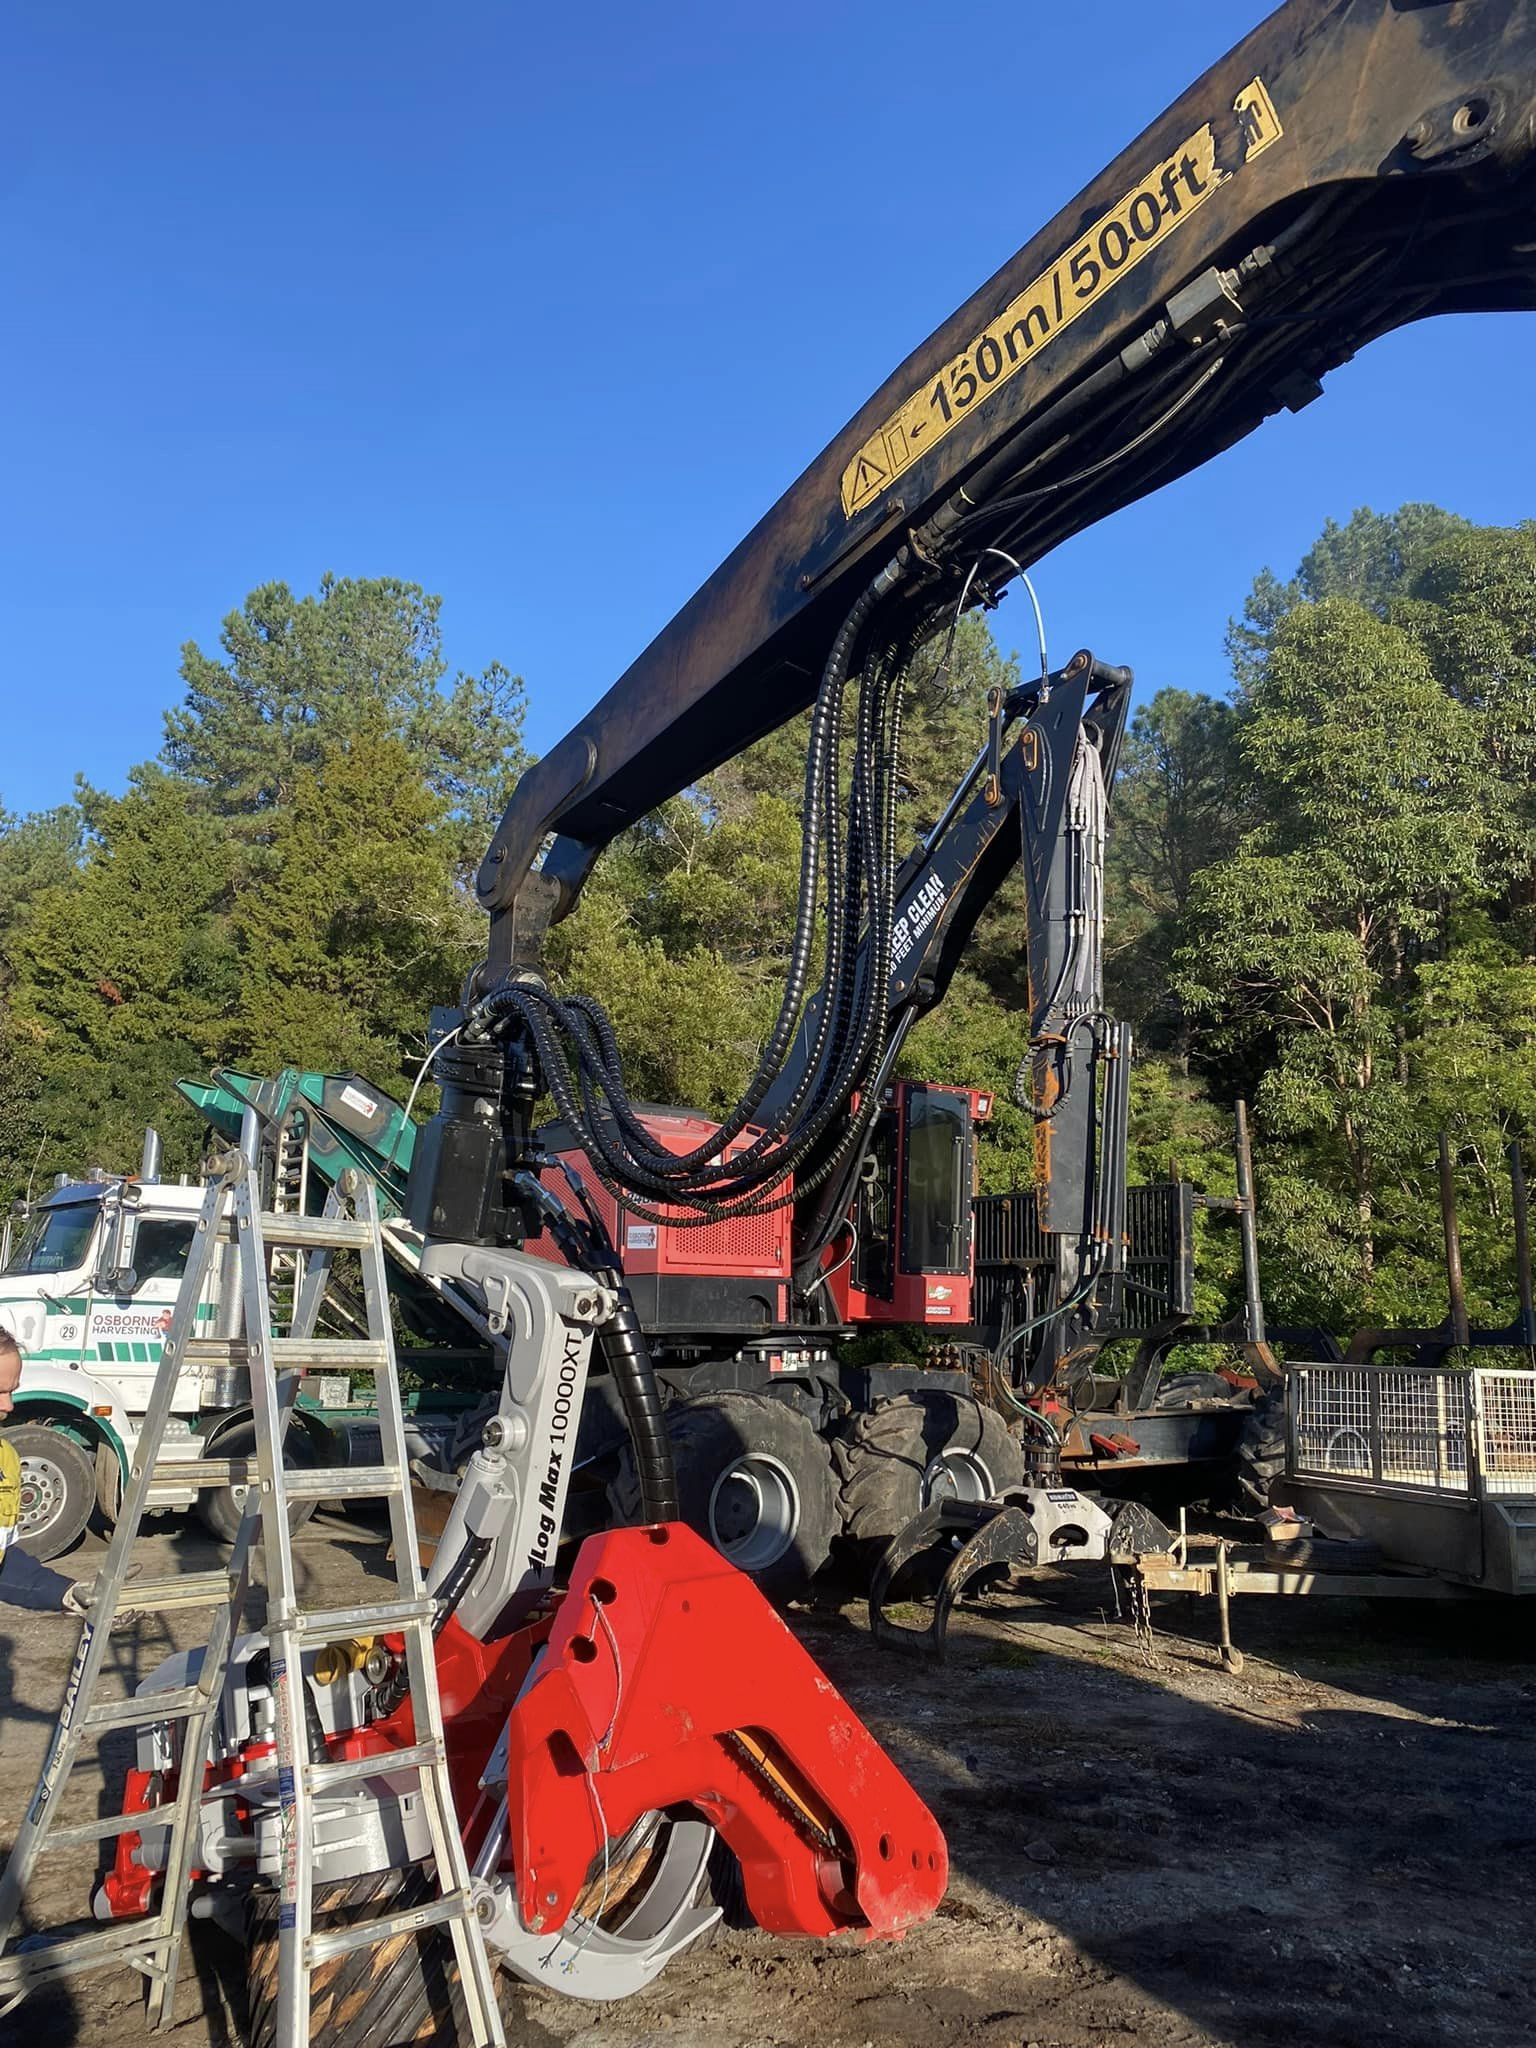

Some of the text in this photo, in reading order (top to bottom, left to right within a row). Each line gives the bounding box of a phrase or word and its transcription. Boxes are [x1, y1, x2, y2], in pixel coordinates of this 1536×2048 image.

[894, 935, 915, 963] FEET
[913, 892, 948, 939] MINIMUM
[62, 1326, 75, 1338] 29
[92, 1326, 158, 1335] HARVESTING
[93, 1315, 159, 1326] OSBORNE
[528, 1333, 583, 1570] Log Max 10000XT
[60, 1621, 92, 1728] BAILEY
